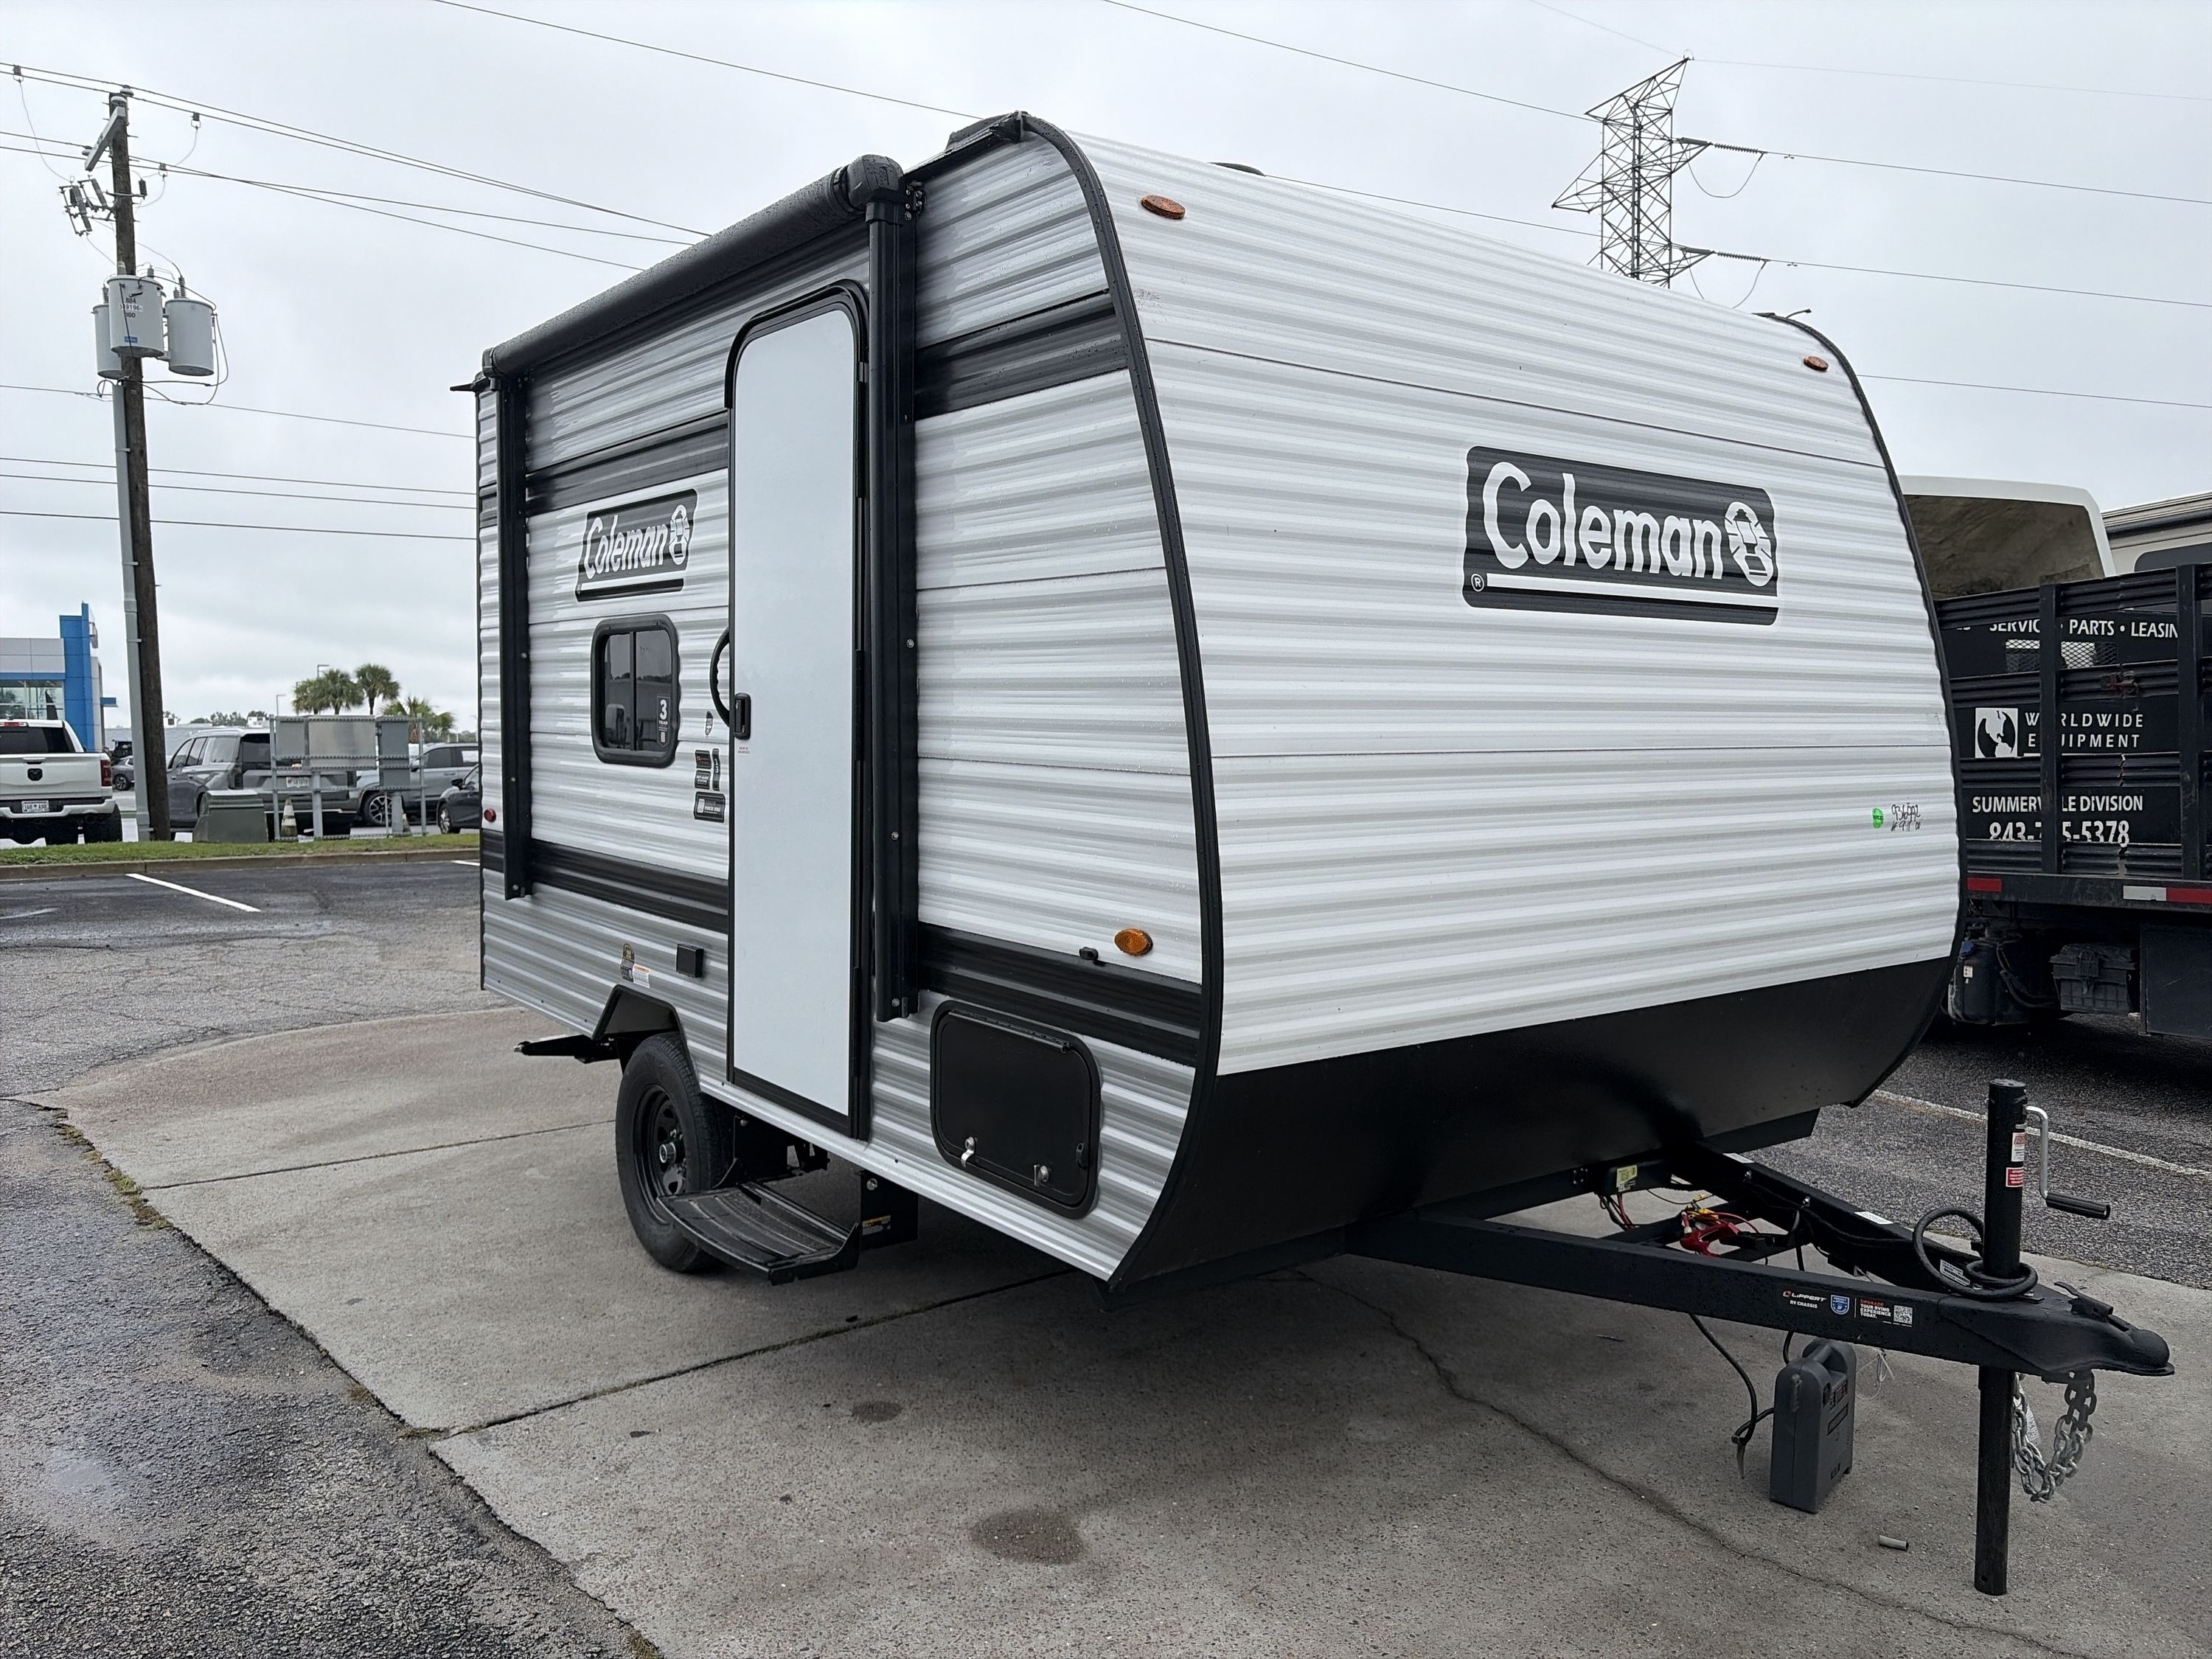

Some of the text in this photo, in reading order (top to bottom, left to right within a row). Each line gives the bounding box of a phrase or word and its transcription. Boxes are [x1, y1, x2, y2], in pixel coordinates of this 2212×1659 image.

[1482, 461, 1723, 580] Coleman
[584, 514, 668, 580] Coleman
[2069, 619, 2115, 636] PARTS
[659, 699, 667, 720] 3
[2025, 712, 2143, 728] WRLDWIDE
[2079, 795, 2143, 812] DIVISION
[1797, 1301, 1818, 1309] CHASSIS
[1860, 1308, 1891, 1317] EXPERIENCE
